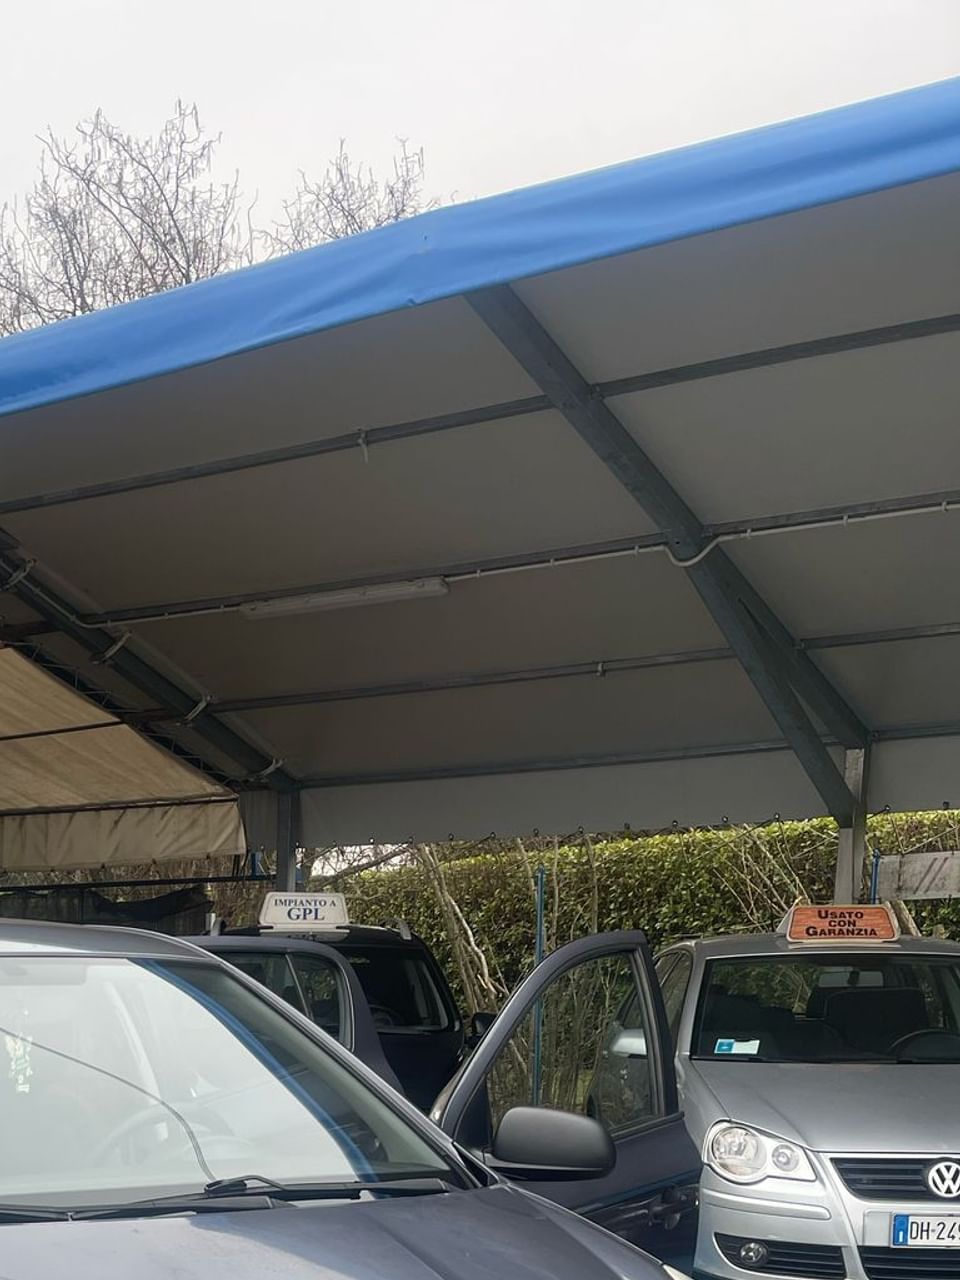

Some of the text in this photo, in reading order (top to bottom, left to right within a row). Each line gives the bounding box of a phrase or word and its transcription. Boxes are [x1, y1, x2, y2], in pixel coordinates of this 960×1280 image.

[274, 899, 337, 907] IMPIANTO A
[287, 907, 325, 921] GPL
